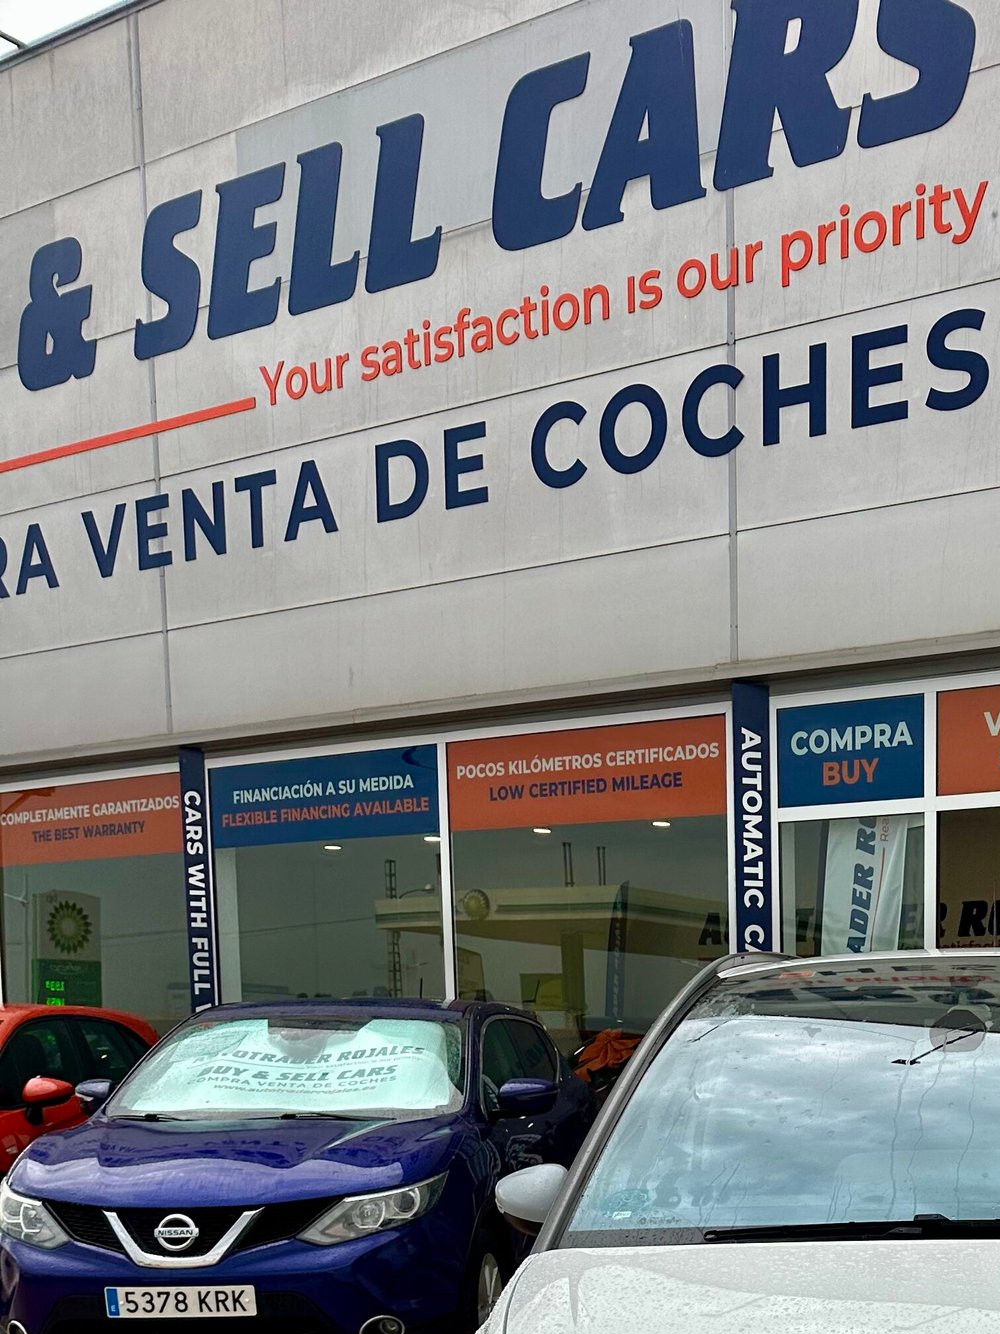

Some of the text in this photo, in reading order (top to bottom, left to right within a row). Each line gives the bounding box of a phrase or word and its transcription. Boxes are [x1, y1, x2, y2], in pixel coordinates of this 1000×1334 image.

[17, 0, 976, 392] & SELL CARS
[259, 357, 350, 407] Your
[361, 281, 610, 384] satisfaction
[677, 240, 763, 296] our
[781, 180, 989, 288] priority
[82, 459, 339, 580] VENTA
[376, 421, 490, 525] DE
[531, 308, 990, 490] COCHES
[790, 721, 914, 757] COMPRA
[456, 742, 720, 780] POCOS KILÓMETROS CERTIFICADOS
[822, 758, 879, 787] BUY
[233, 774, 414, 804] FINANCIACIÓN A SU MEDIDA
[489, 771, 683, 801] LOW CERTIFIED MILEAGE
[1, 796, 180, 826] COMPLETAMENTE GARANTIZADOS
[184, 790, 204, 856] CARS
[222, 797, 430, 828] FLEXIBLE FINANCING AVAILABLE
[740, 726, 765, 910] AUTOMATIC
[32, 821, 145, 843] THE BEST WARRANTY
[188, 864, 208, 928] WITH
[192, 937, 211, 995] FULL
[337, 1046, 424, 1061] ROJALES
[197, 1066, 249, 1077] BUY
[276, 1072, 329, 1081] SELL
[337, 1065, 398, 1079] CARS
[338, 1076, 397, 1086] COCHES
[124, 1291, 188, 1313] 5378
[198, 1290, 247, 1313] KRK
